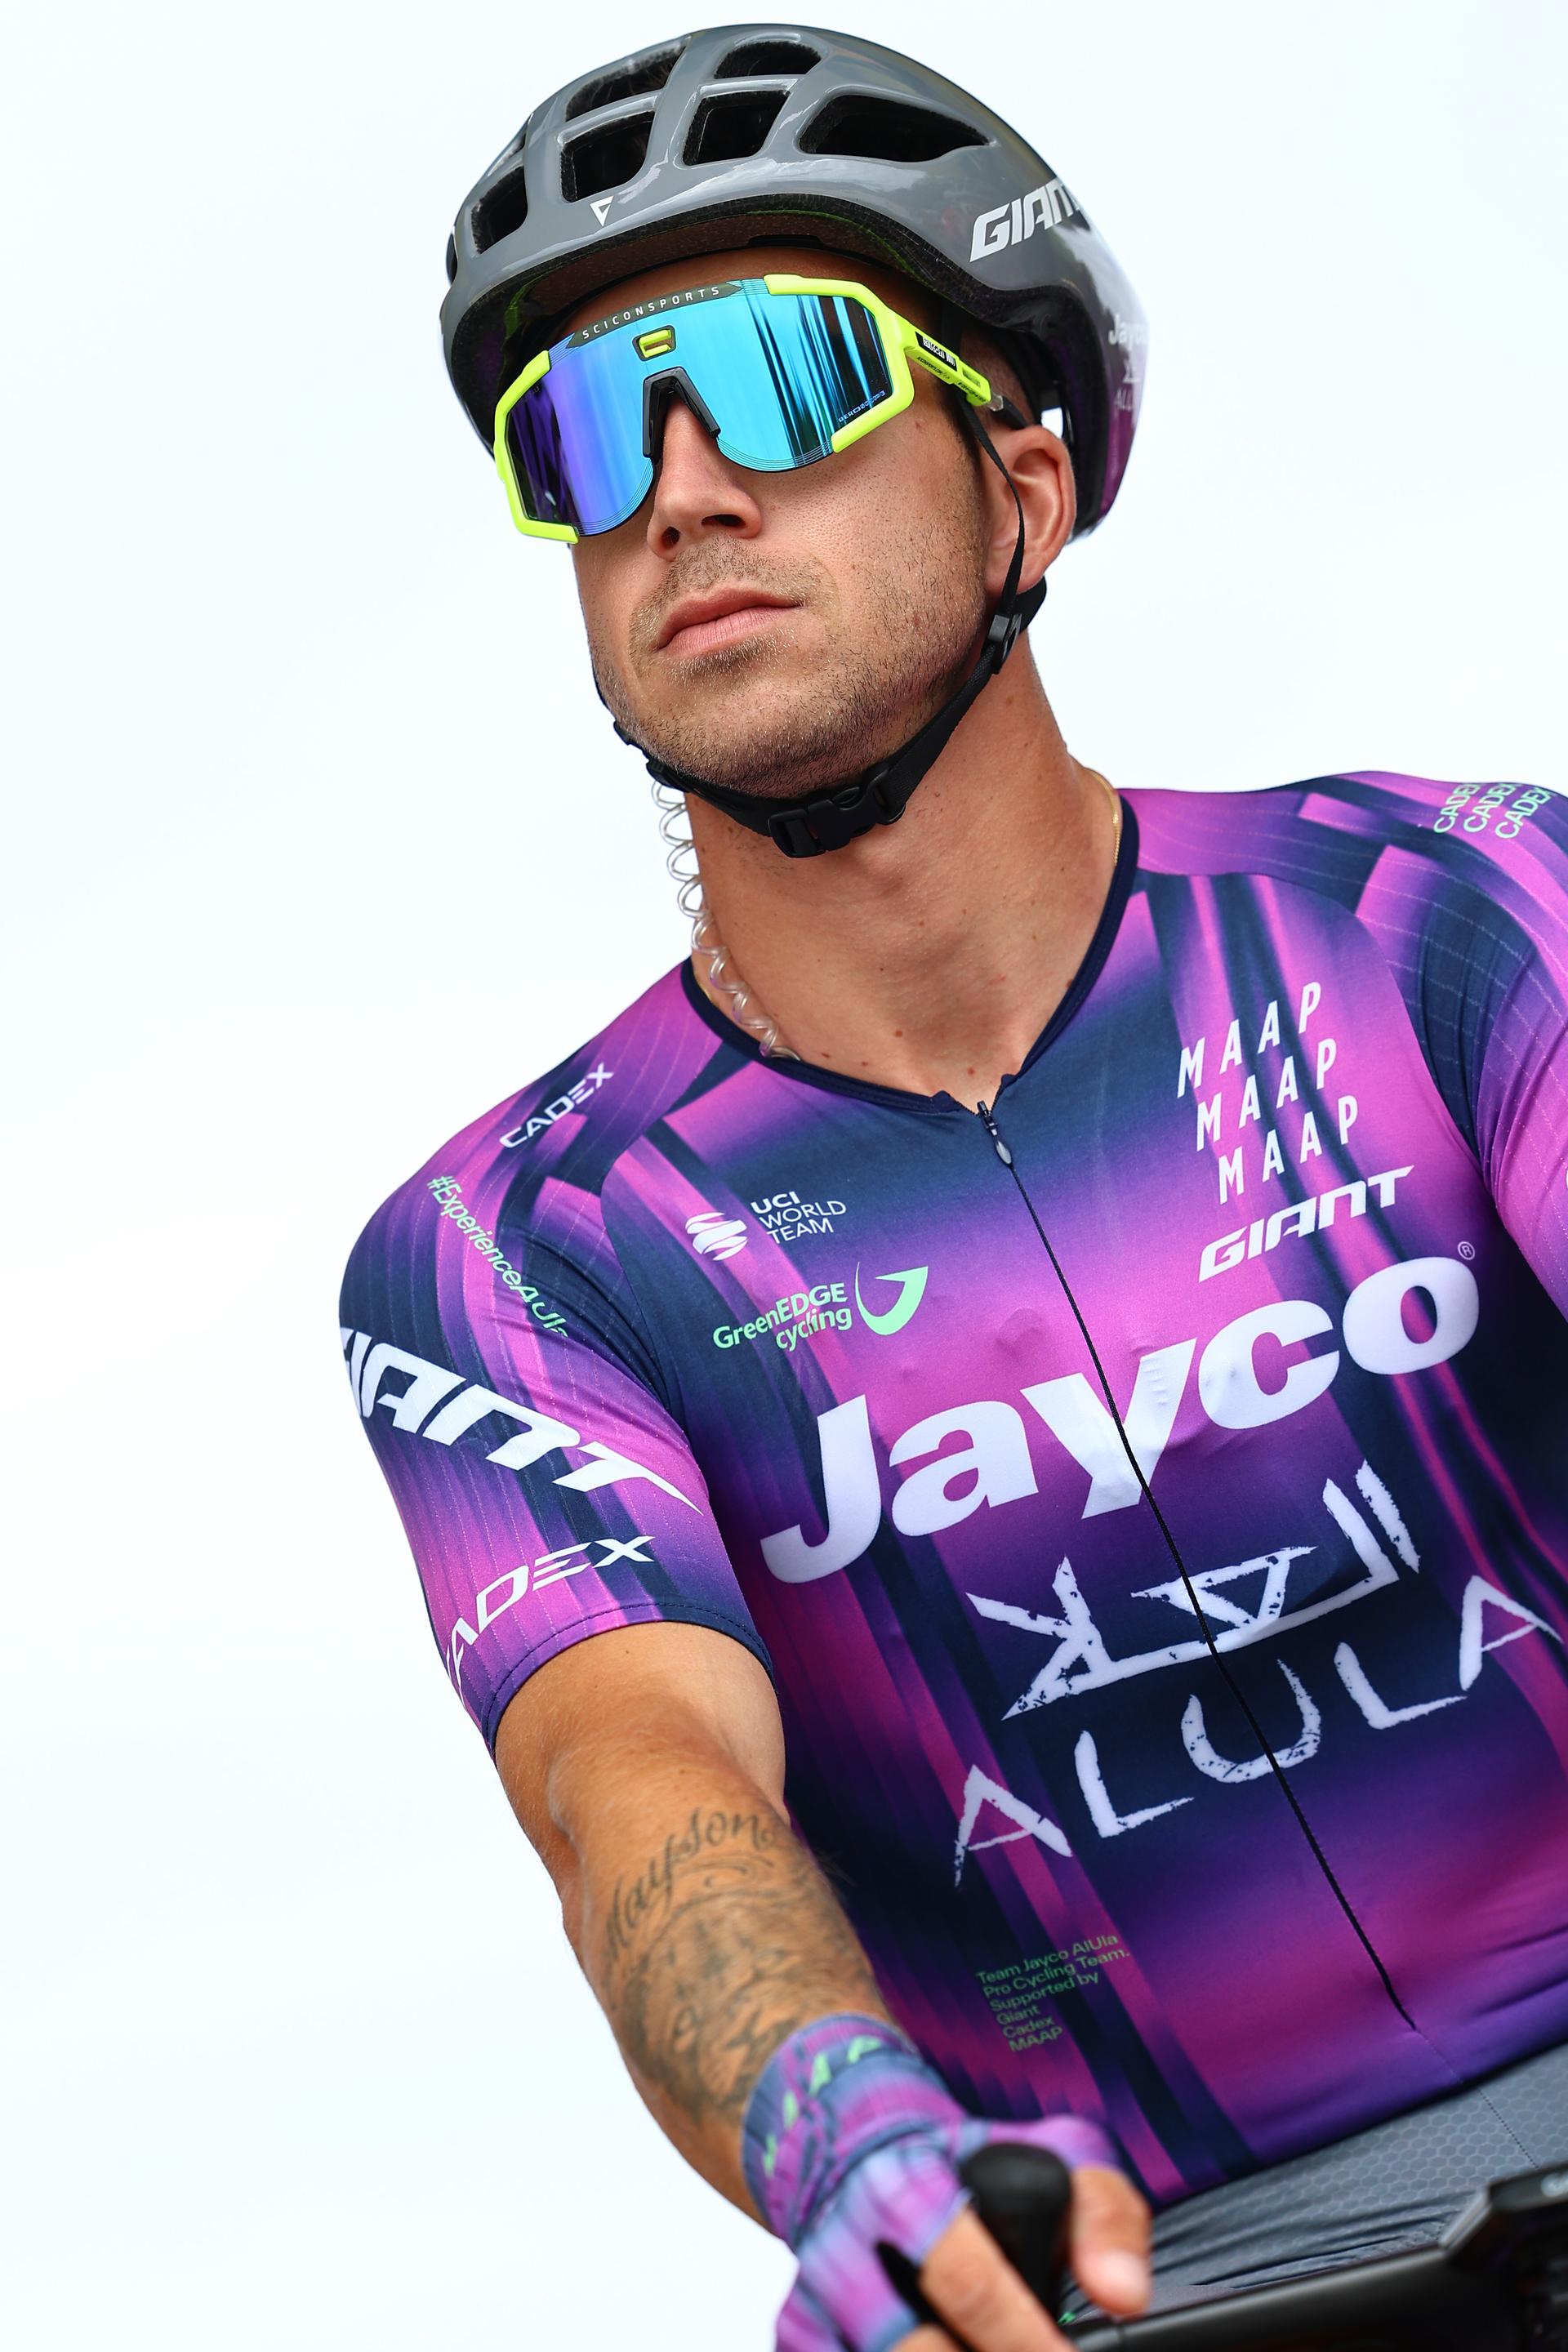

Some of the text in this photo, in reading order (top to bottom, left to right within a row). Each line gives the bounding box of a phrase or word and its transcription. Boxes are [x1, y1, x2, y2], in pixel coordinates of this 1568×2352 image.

[969, 177, 1079, 262] GIAN
[581, 286, 720, 340] SCICONSPORTS
[1433, 783, 1482, 833] CADE
[1463, 783, 1519, 833] CADE
[1177, 982, 1321, 1098] MAAP
[499, 1062, 614, 1148] CADEX
[1196, 1038, 1337, 1152] MAAP
[1218, 1094, 1358, 1205] MAAP
[750, 1191, 801, 1214] UCI
[759, 1200, 847, 1230] WORLD
[1198, 1165, 1414, 1283] GIANT
[766, 1218, 834, 1245] TEAM
[712, 1282, 849, 1349] GreenEDGE
[775, 1307, 853, 1352] cycling
[340, 1326, 705, 1517] IANT
[759, 1256, 1480, 1584] Jayco
[446, 1535, 656, 1710] ADEX
[954, 1575, 1564, 1888] ALULA
[976, 1965, 1021, 1984] Team
[1022, 1950, 1069, 1971] Jayco
[982, 1984, 1012, 1999] Pro
[1013, 1962, 1076, 1990] Cycling
[989, 1972, 1099, 2012] Supported by
[996, 2004, 1040, 2025] Giant
[1003, 2016, 1055, 2038] Cadex
[1008, 2025, 1063, 2051] MAAP
